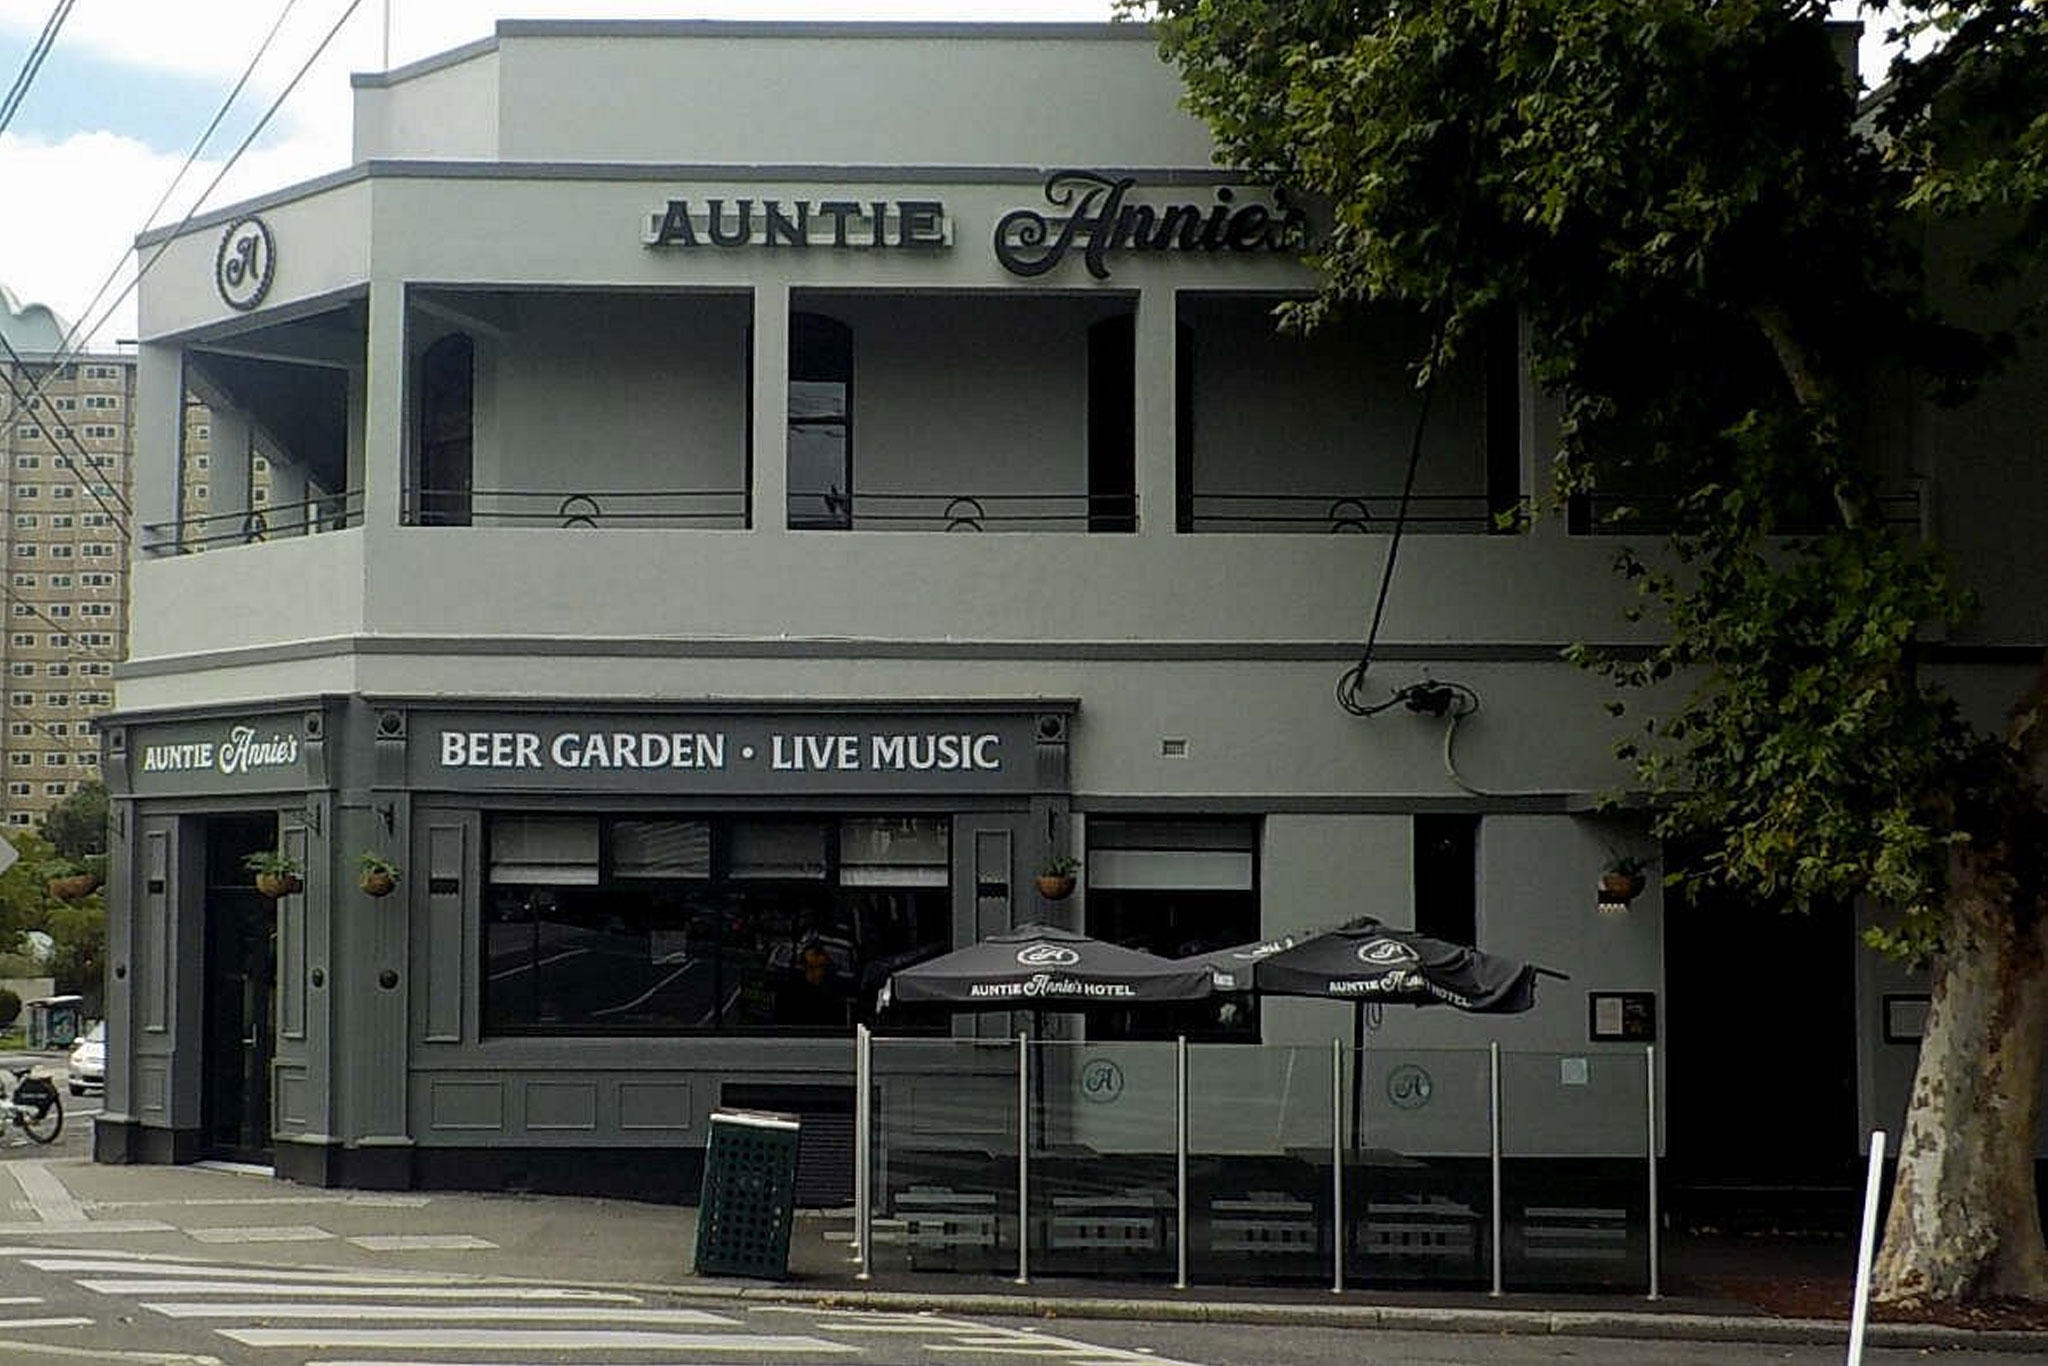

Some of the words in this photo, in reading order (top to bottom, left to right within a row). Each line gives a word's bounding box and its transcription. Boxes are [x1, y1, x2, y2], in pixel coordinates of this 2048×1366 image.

[652, 199, 944, 248] AUNTIE
[144, 743, 213, 771] AUNTIE
[219, 725, 298, 774] Annie's
[441, 731, 542, 767] BEER
[551, 733, 724, 767] GARDEN
[772, 735, 860, 769] LIVE
[871, 734, 1000, 769] MUSIC
[970, 983, 1022, 997] AUNTIE
[1084, 984, 1136, 997] HOTEL
